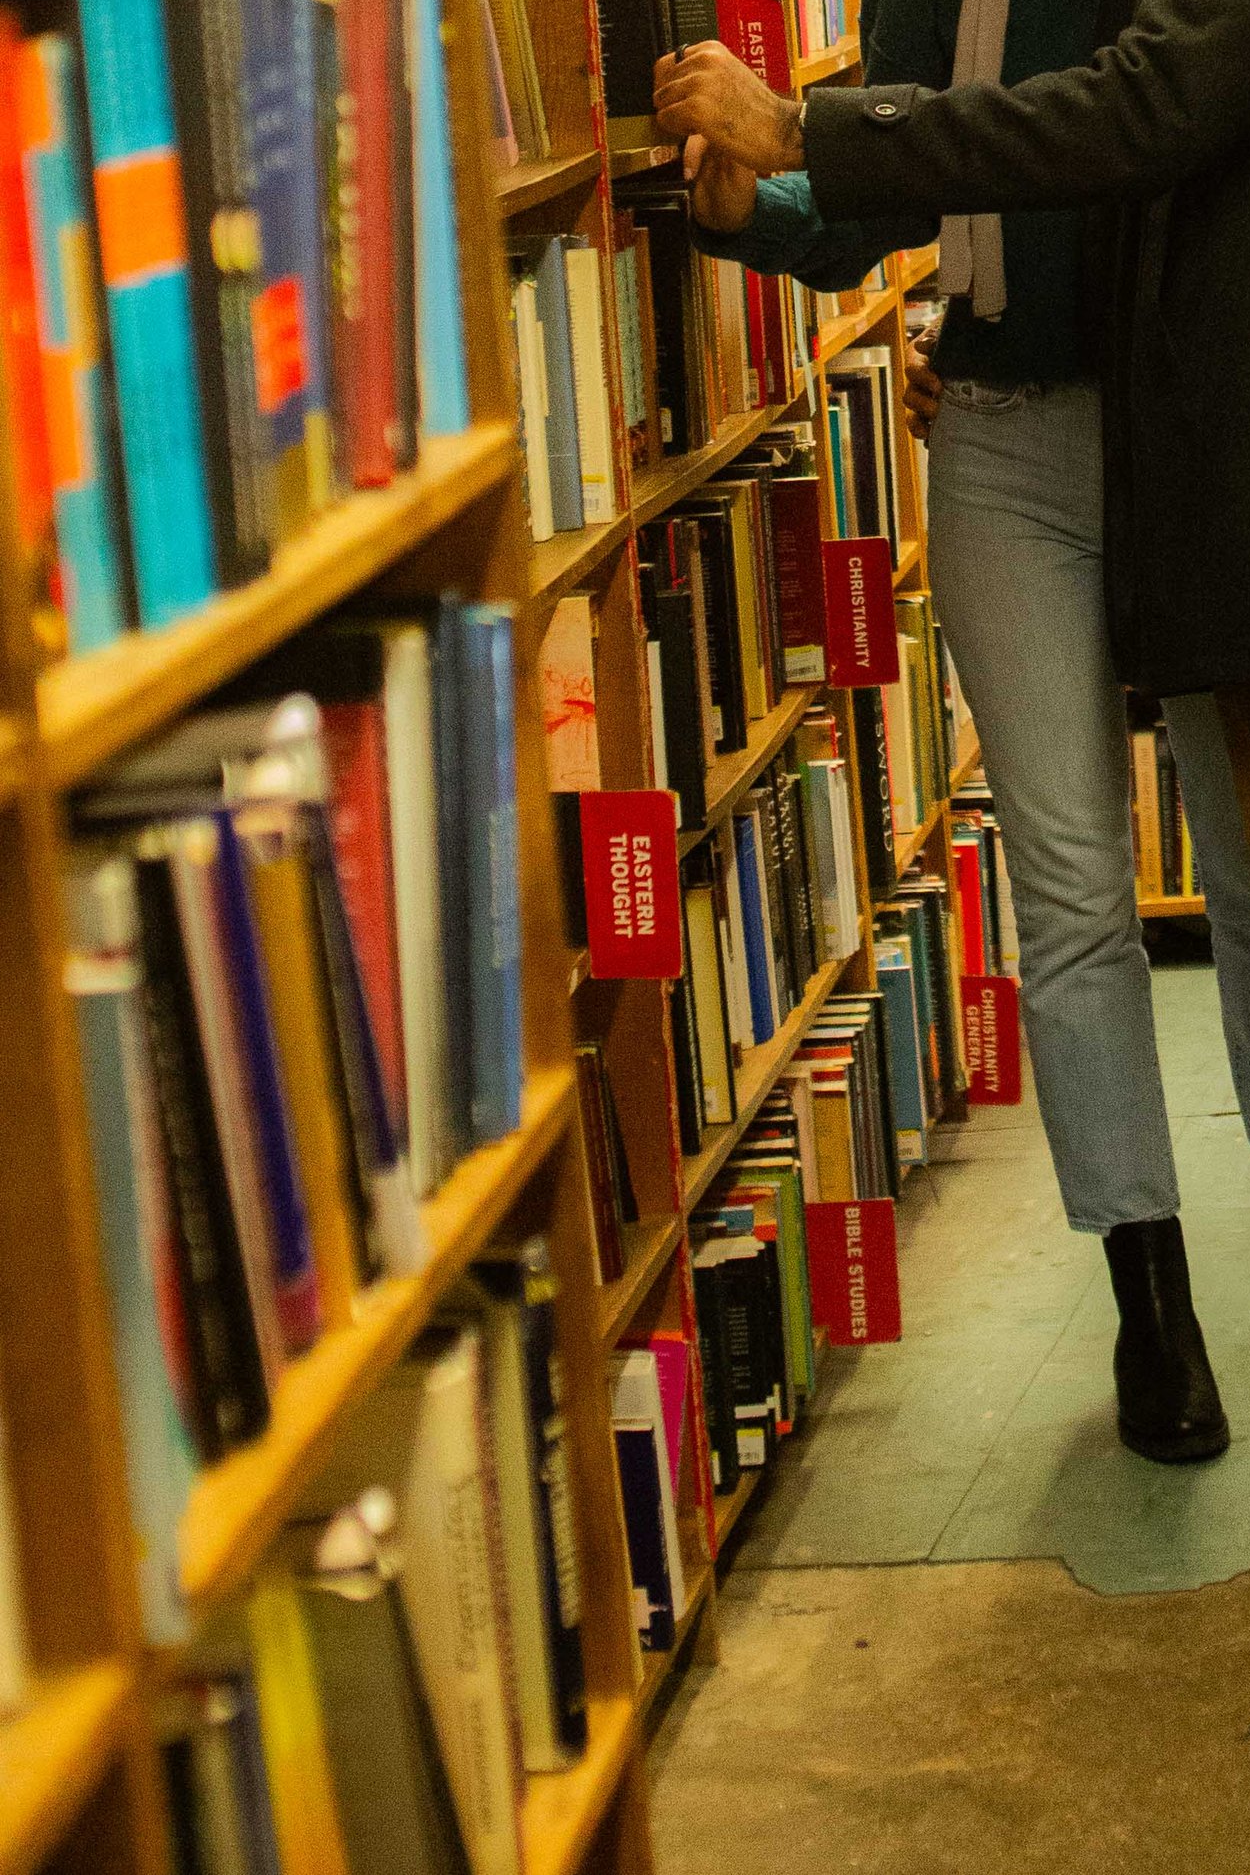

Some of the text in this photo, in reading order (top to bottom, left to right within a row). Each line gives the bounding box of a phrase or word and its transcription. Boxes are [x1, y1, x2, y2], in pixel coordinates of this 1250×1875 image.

[748, 22, 766, 83] EASTE
[847, 556, 871, 669] CHRISTIANITY
[875, 723, 893, 852] SWORD
[608, 832, 633, 940] THOUGHT
[631, 834, 656, 937] EASTERN
[981, 988, 999, 1093] CHRISTIANITY
[843, 1207, 869, 1339] BIBLE STUDIES
